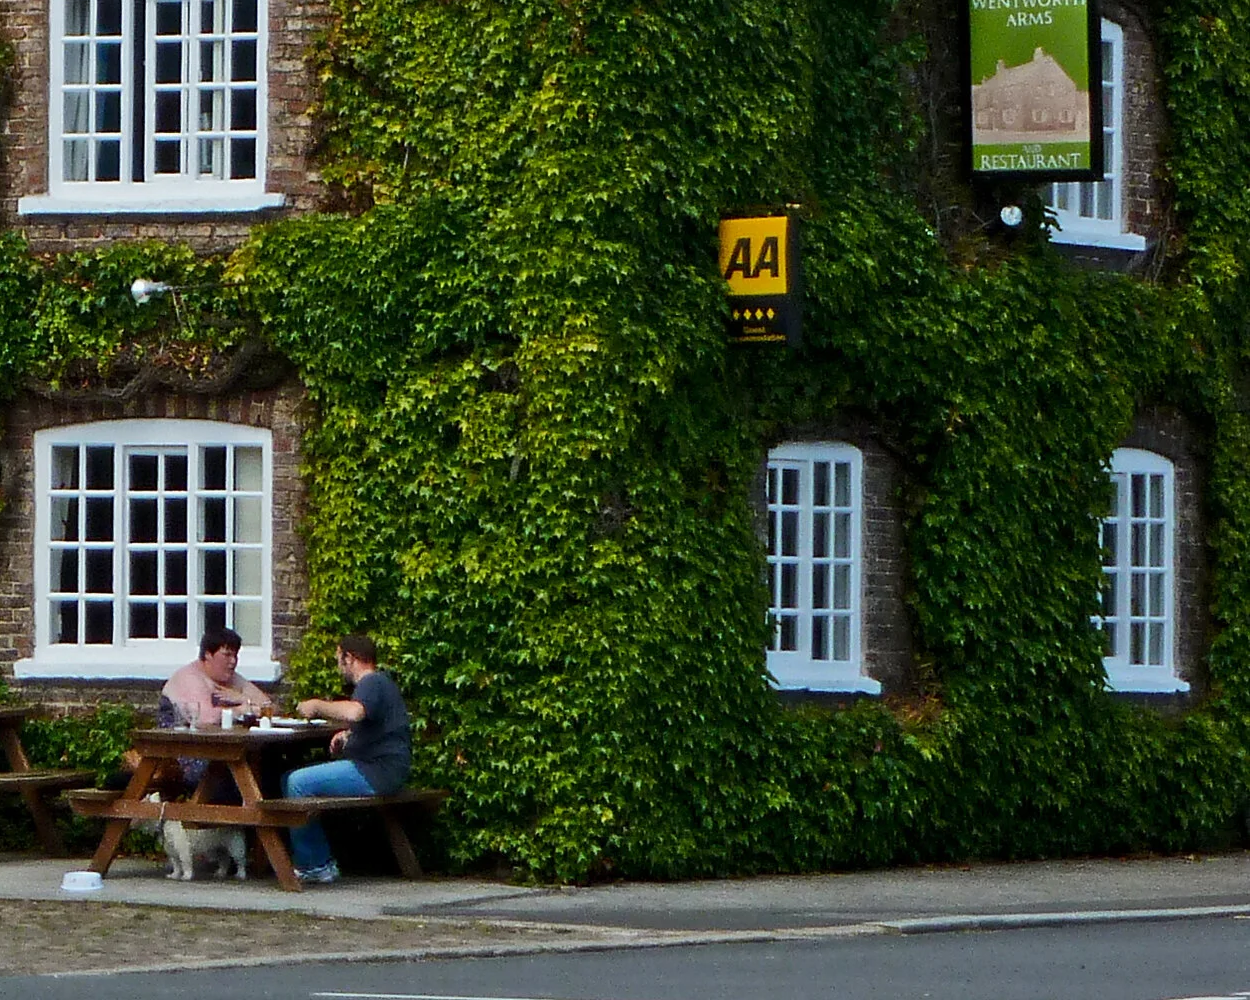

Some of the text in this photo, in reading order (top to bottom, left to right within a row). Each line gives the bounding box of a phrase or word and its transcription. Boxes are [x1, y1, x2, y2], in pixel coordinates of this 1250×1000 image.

[1006, 11, 1053, 27] ARMS
[980, 153, 1081, 170] RESTAURANT
[725, 236, 778, 280] AA
